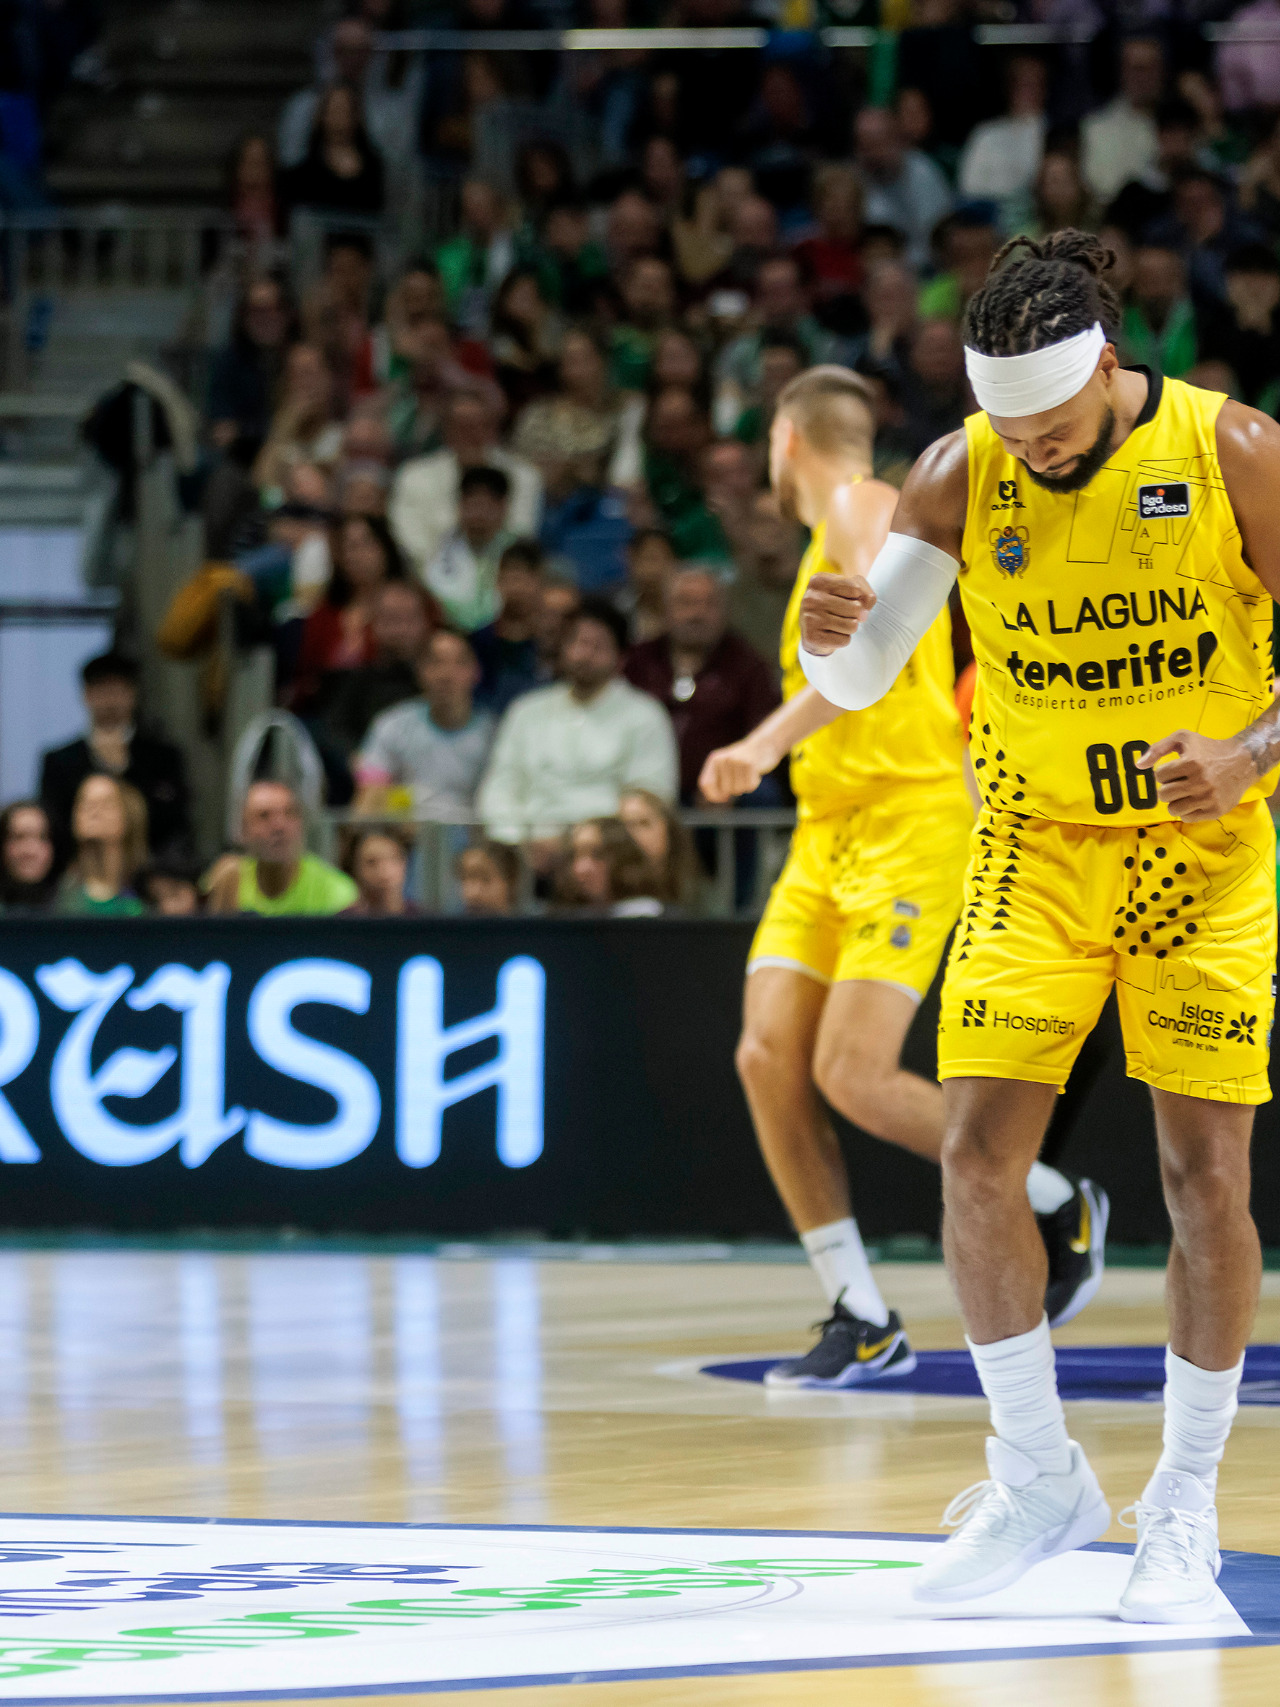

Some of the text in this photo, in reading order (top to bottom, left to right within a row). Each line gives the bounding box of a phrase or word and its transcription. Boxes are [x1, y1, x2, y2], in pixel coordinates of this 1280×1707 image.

[1142, 495, 1163, 506] liga
[1143, 503, 1187, 515] endesa
[1140, 527, 1150, 538] A
[991, 586, 1209, 636] LA LAGUNA
[1015, 681, 1195, 710] despierta emociones
[1086, 740, 1158, 815] 86
[993, 1010, 1075, 1036] Hospiten
[1148, 1010, 1222, 1039] Canarias
[1181, 1001, 1224, 1024] Islas
